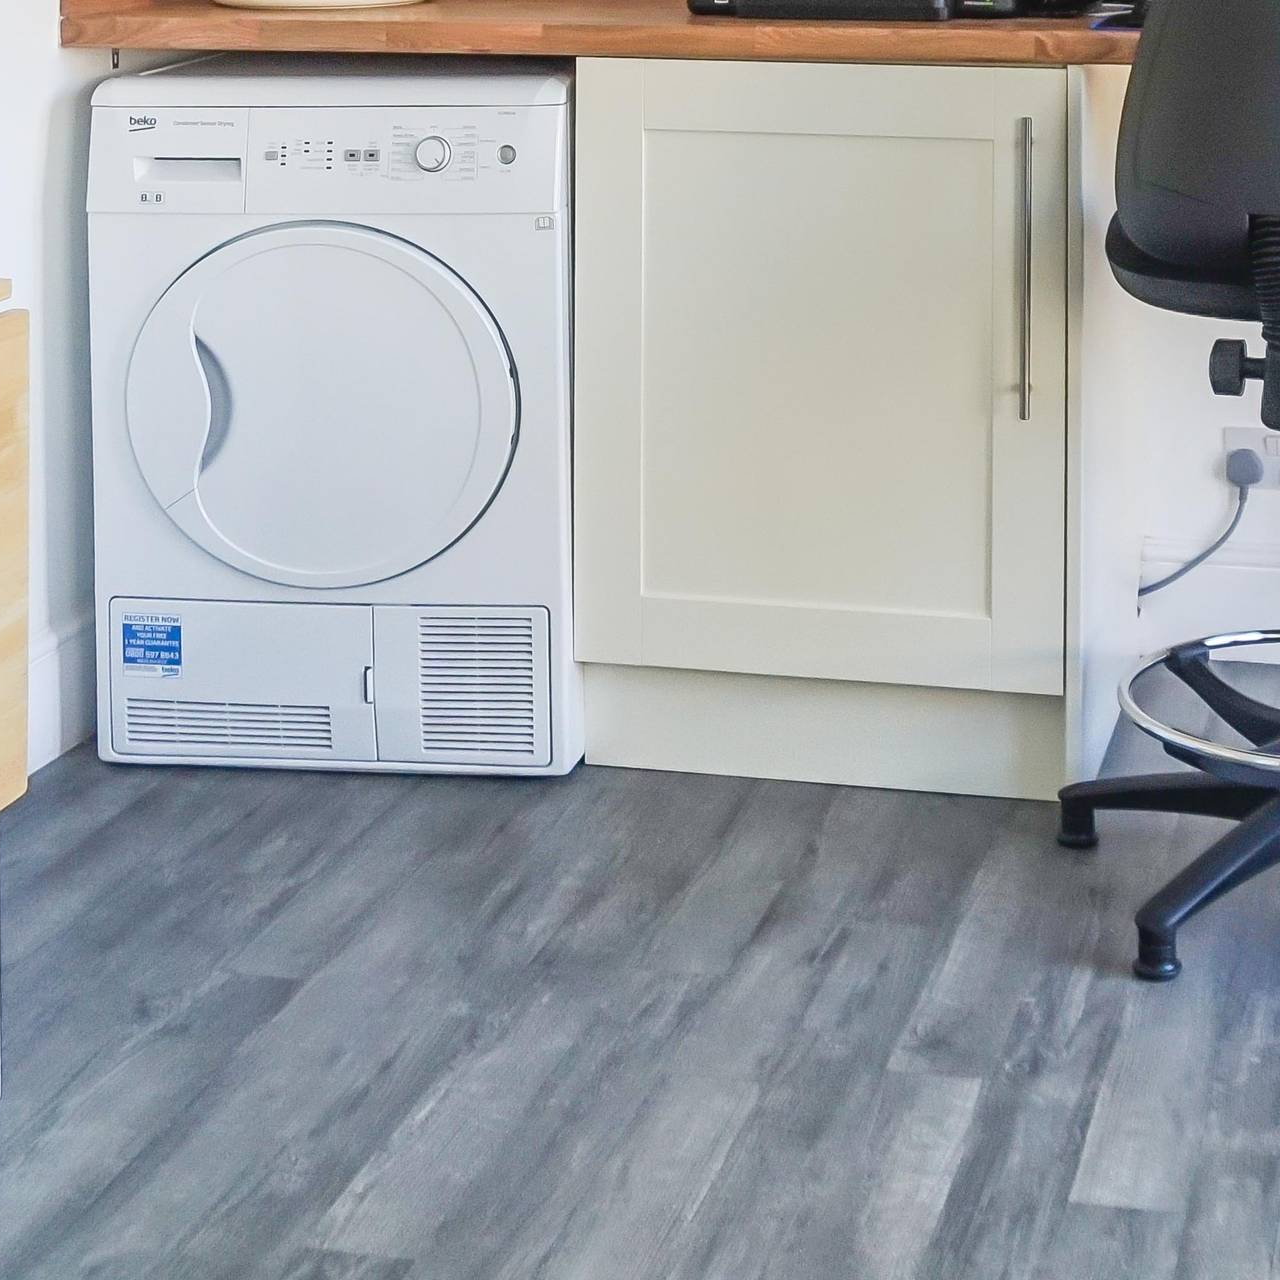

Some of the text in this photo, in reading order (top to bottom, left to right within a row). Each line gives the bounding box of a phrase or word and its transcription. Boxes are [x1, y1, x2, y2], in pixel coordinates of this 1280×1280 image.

[129, 115, 157, 126] beko
[124, 615, 180, 624] REGISTER NOW
